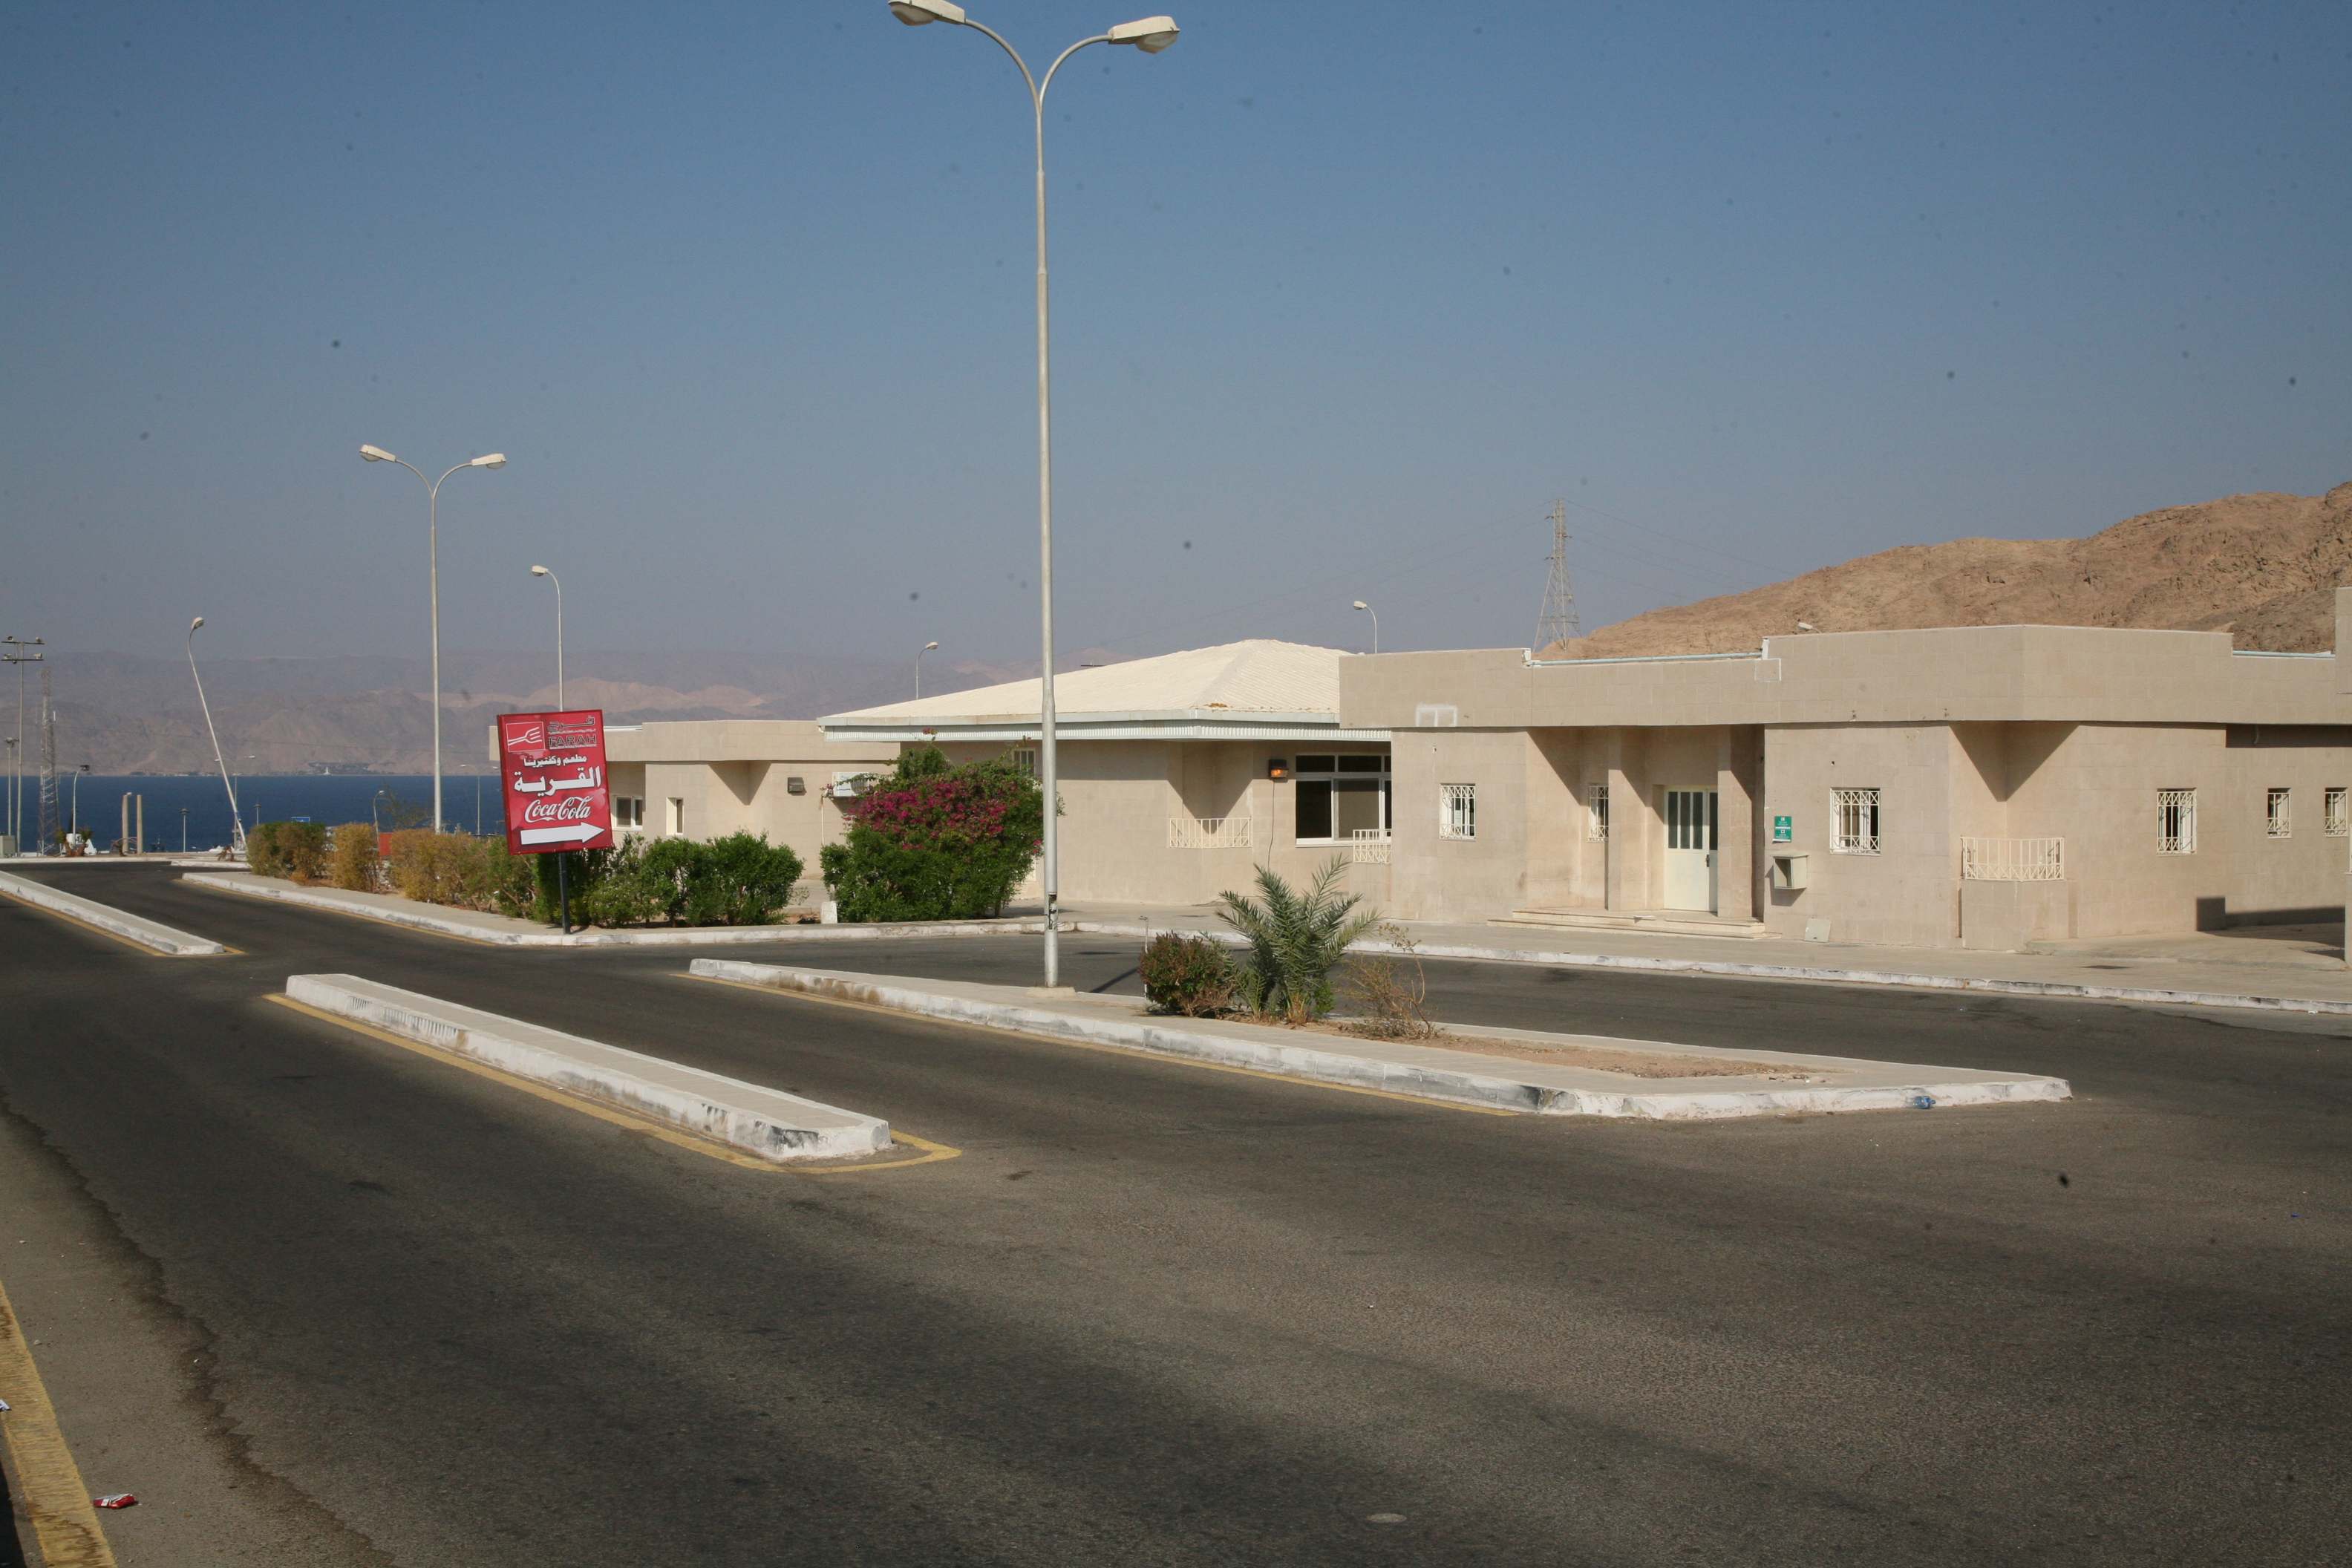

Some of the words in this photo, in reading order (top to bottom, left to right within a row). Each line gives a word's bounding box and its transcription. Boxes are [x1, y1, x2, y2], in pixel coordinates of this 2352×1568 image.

[547, 715, 595, 732] فرح
[549, 734, 596, 747] FARAH
[523, 755, 561, 768] وكفتيريا
[563, 754, 587, 766] مطعم
[514, 765, 601, 797] القرية
